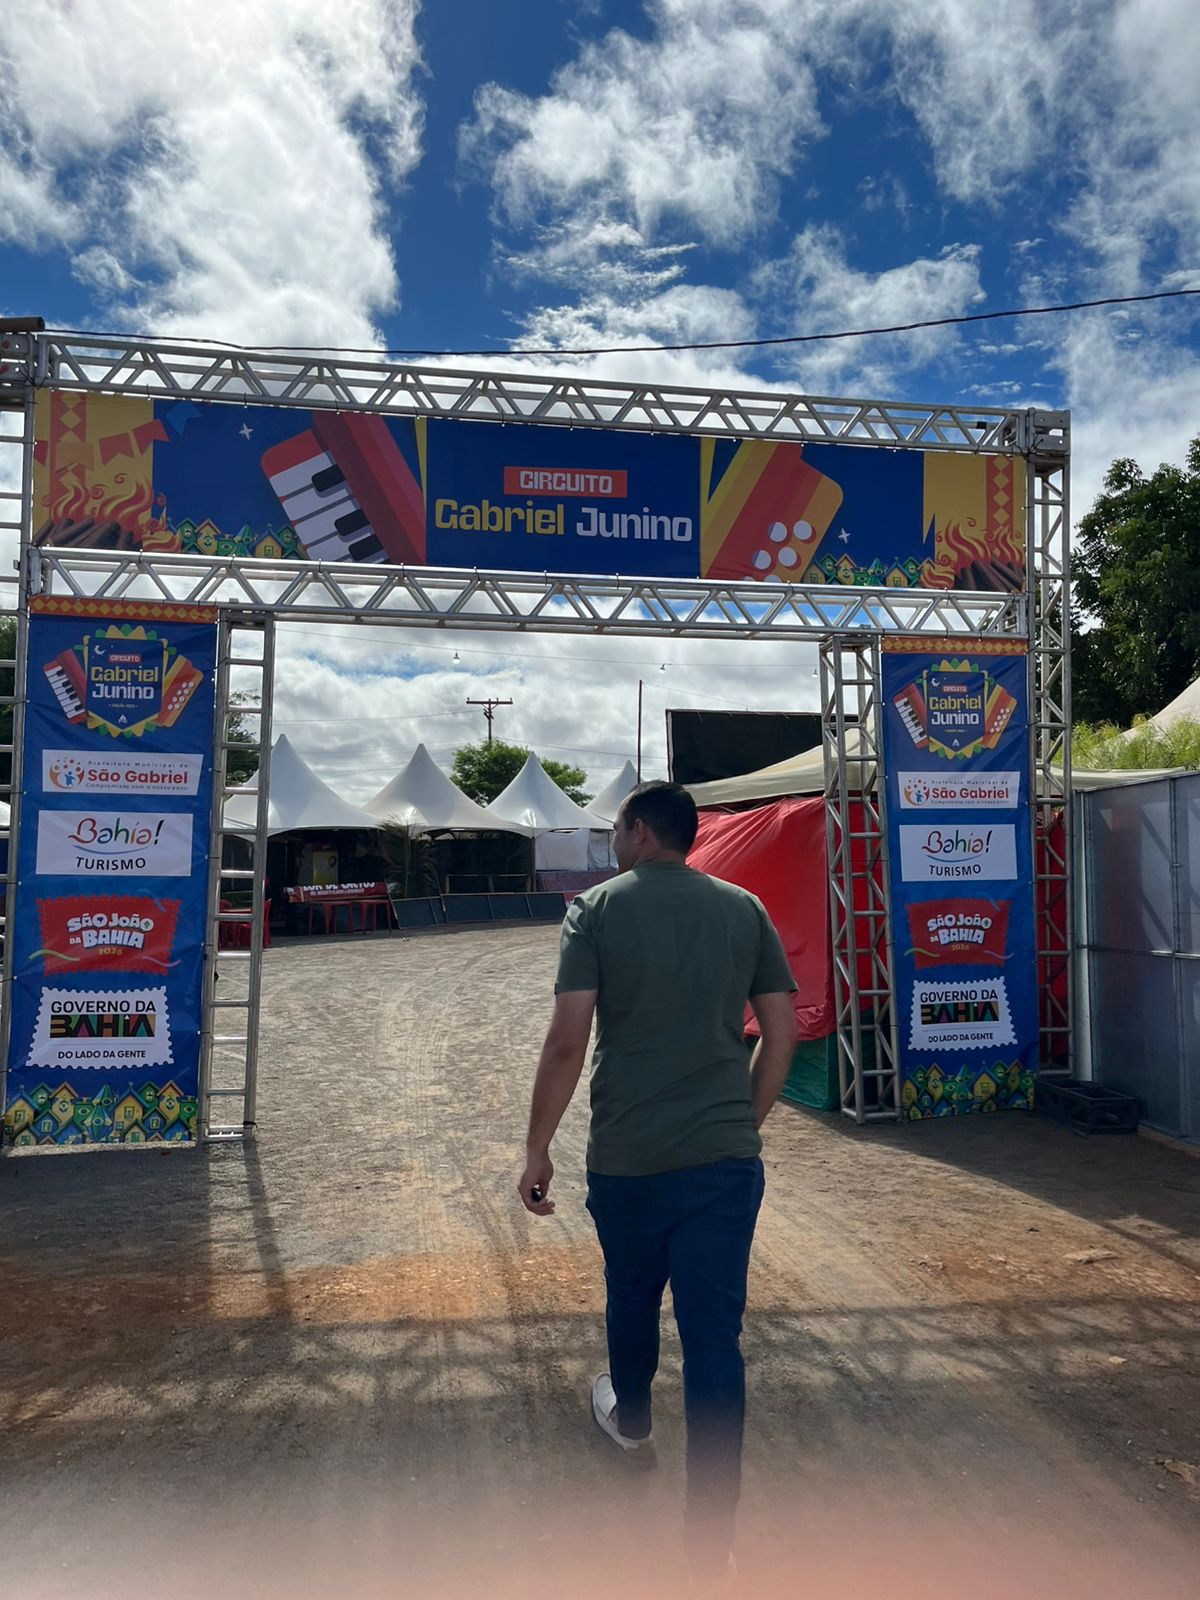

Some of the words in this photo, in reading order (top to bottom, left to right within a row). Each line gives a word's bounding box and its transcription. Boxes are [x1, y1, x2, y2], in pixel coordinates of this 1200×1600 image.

[519, 470, 613, 494] CIRCUITO
[434, 498, 564, 535] Gabriel
[576, 507, 692, 542] Junino
[91, 665, 159, 682] Gabriel
[92, 682, 154, 699] Junino
[929, 694, 982, 710] Gabriel
[931, 710, 979, 725] Junino
[87, 768, 121, 782] São
[125, 770, 188, 784] Gabriel
[932, 787, 957, 799] São
[959, 786, 1009, 799] Gabriel
[76, 856, 146, 871] TURISMO
[928, 864, 982, 877] TURISMO
[69, 937, 82, 945] DA
[81, 929, 145, 949] BAHIA
[938, 927, 985, 945] BAHIA
[920, 989, 978, 1003] GOVERNO
[981, 989, 998, 1000] DA
[51, 1000, 131, 1013] GOVERNO
[135, 1000, 156, 1013] DA
[920, 1001, 1000, 1025] BAHIA
[50, 1014, 156, 1038] BAHIA
[928, 1035, 938, 1043] DO
[939, 1034, 959, 1042] LADO
[970, 1032, 994, 1041] GENTE
[58, 1051, 73, 1059] DO
[75, 1051, 101, 1059] LADO
[102, 1051, 116, 1059] DA
[117, 1050, 147, 1058] GENTE
